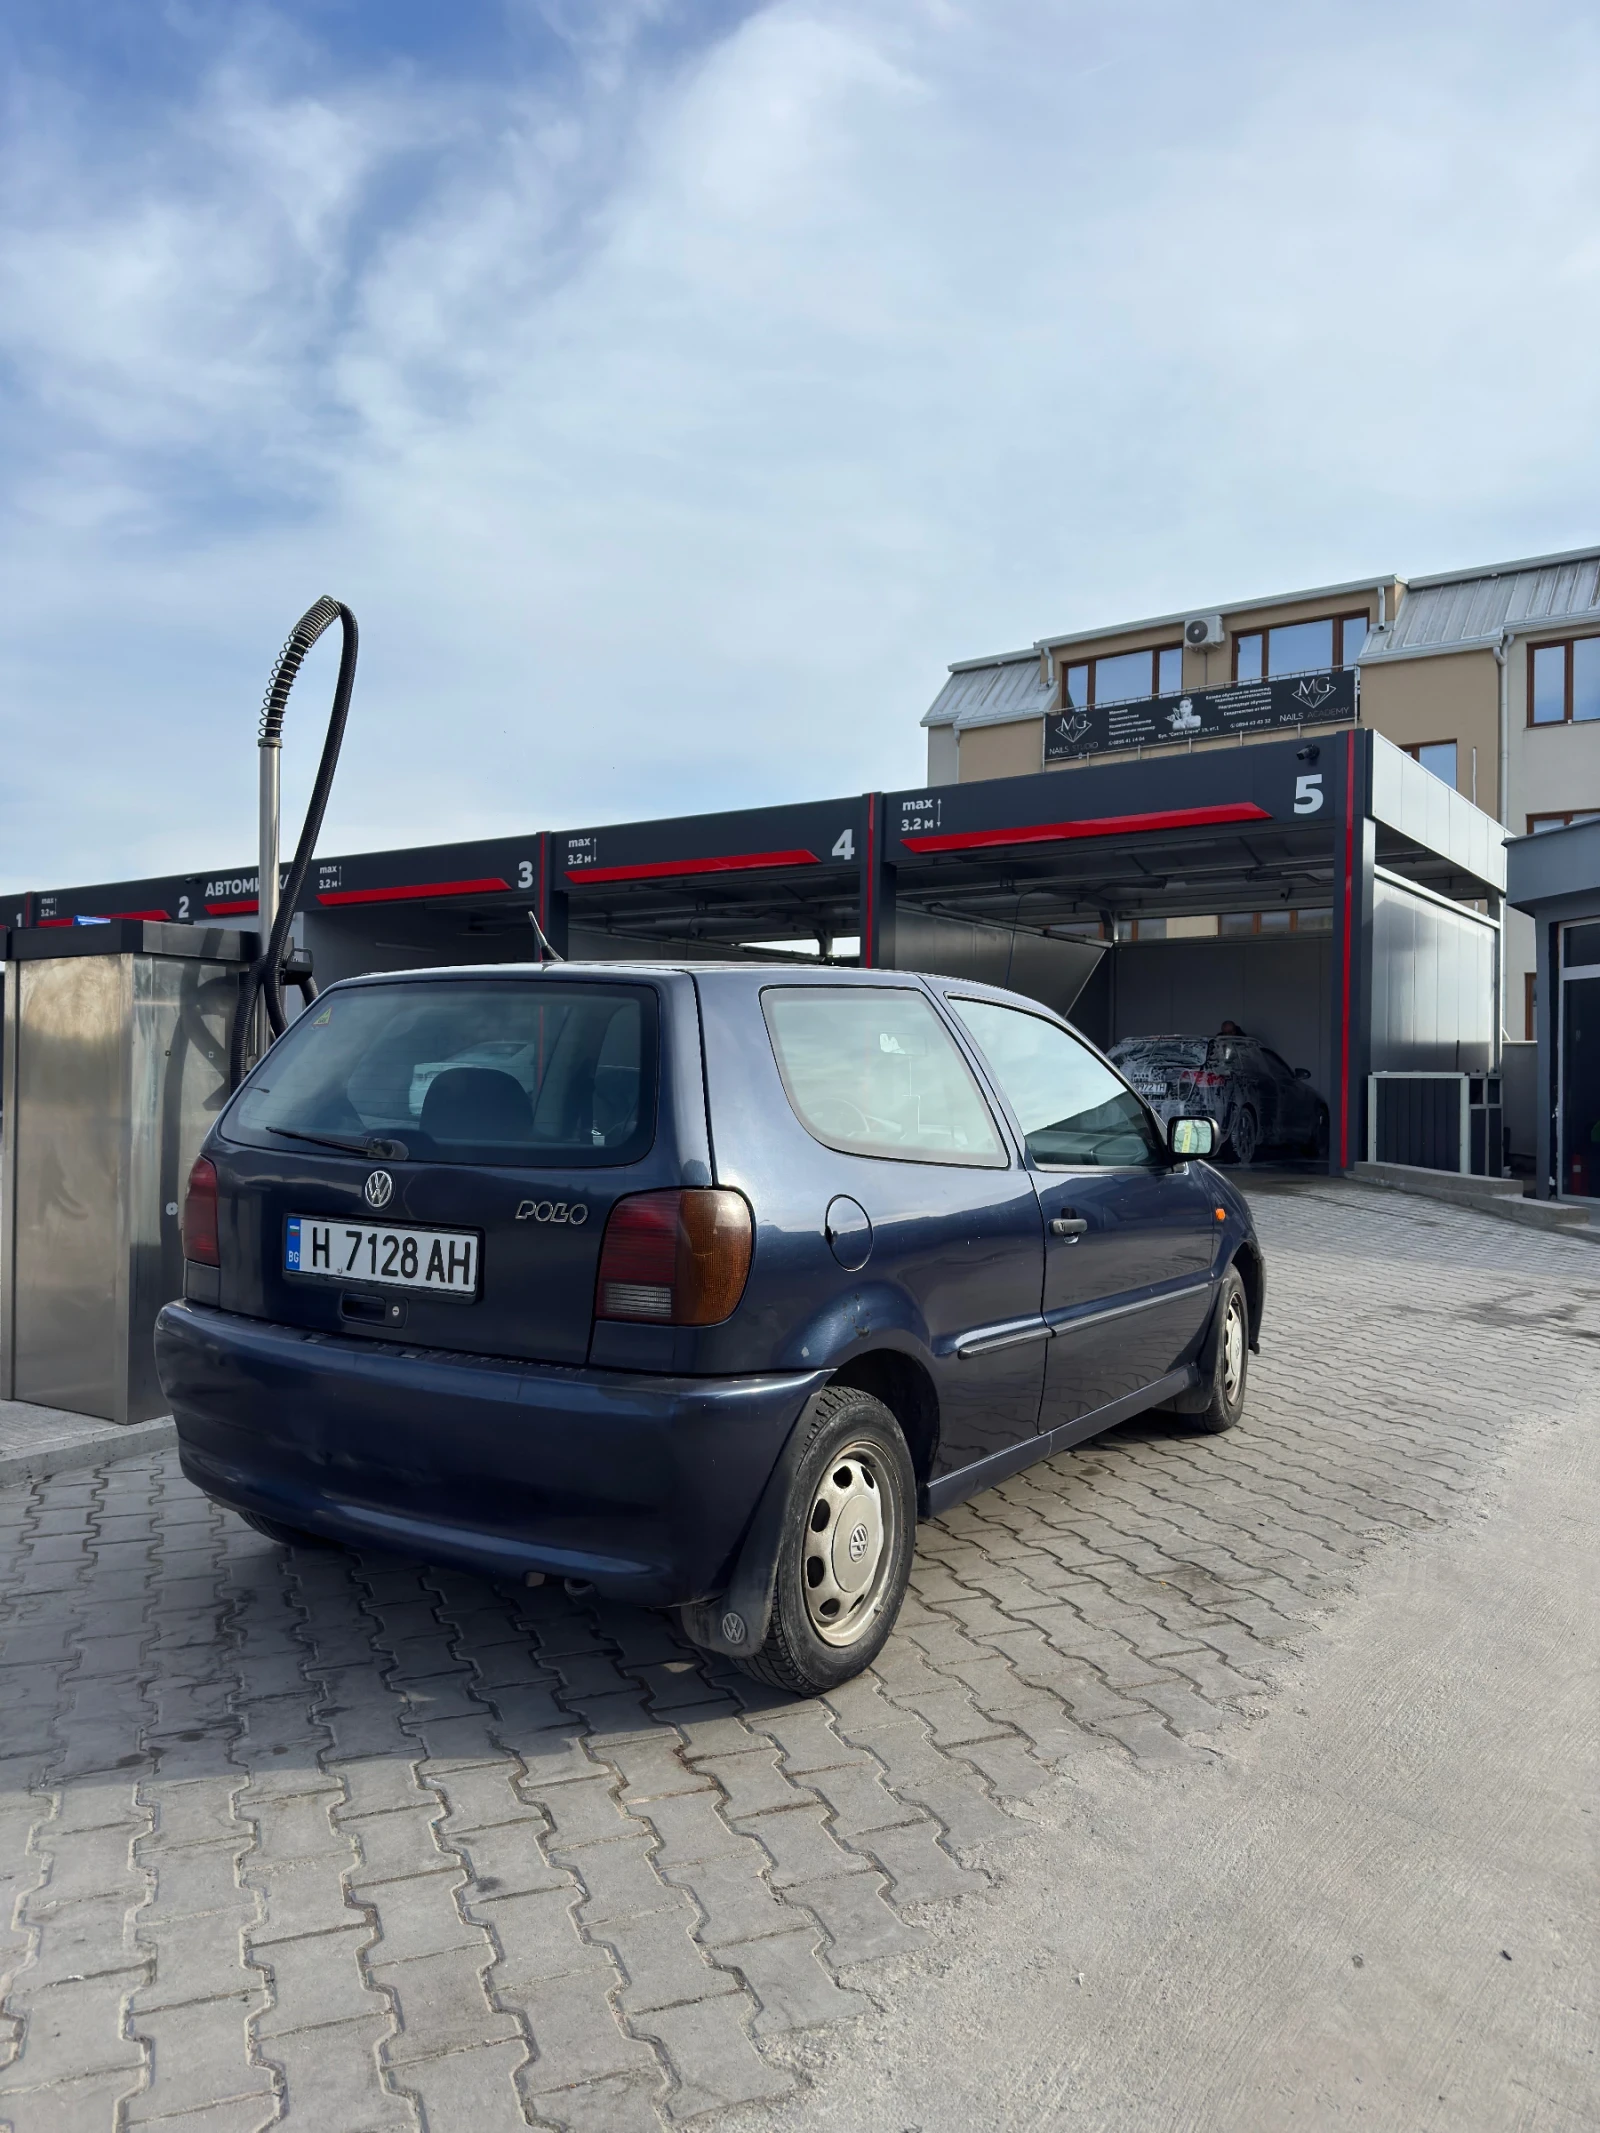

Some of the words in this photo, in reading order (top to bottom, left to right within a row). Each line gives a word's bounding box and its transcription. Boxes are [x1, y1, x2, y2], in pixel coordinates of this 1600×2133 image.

[1298, 677, 1330, 696] MG
[1280, 712, 1304, 722] NAILS
[1306, 706, 1350, 718] ACADEMY
[1060, 714, 1087, 732] MG
[1050, 746, 1069, 755] NAILS
[1072, 742, 1098, 751] STUDIO
[1294, 774, 1324, 814] 5
[902, 799, 933, 811] max
[901, 818, 922, 832] 3.2
[568, 837, 591, 848] max
[832, 829, 855, 860] 4
[568, 854, 582, 865] 3.2
[320, 866, 337, 874] max
[518, 861, 533, 888] 3
[205, 874, 290, 897] АВТОМК
[319, 879, 330, 889] 3.2
[178, 896, 189, 918] 2
[16, 913, 22, 927] 1
[515, 1200, 588, 1225] POLO
[288, 1250, 299, 1263] BG
[312, 1226, 330, 1268] H
[346, 1230, 418, 1279] 7128
[426, 1238, 470, 1285] AH
